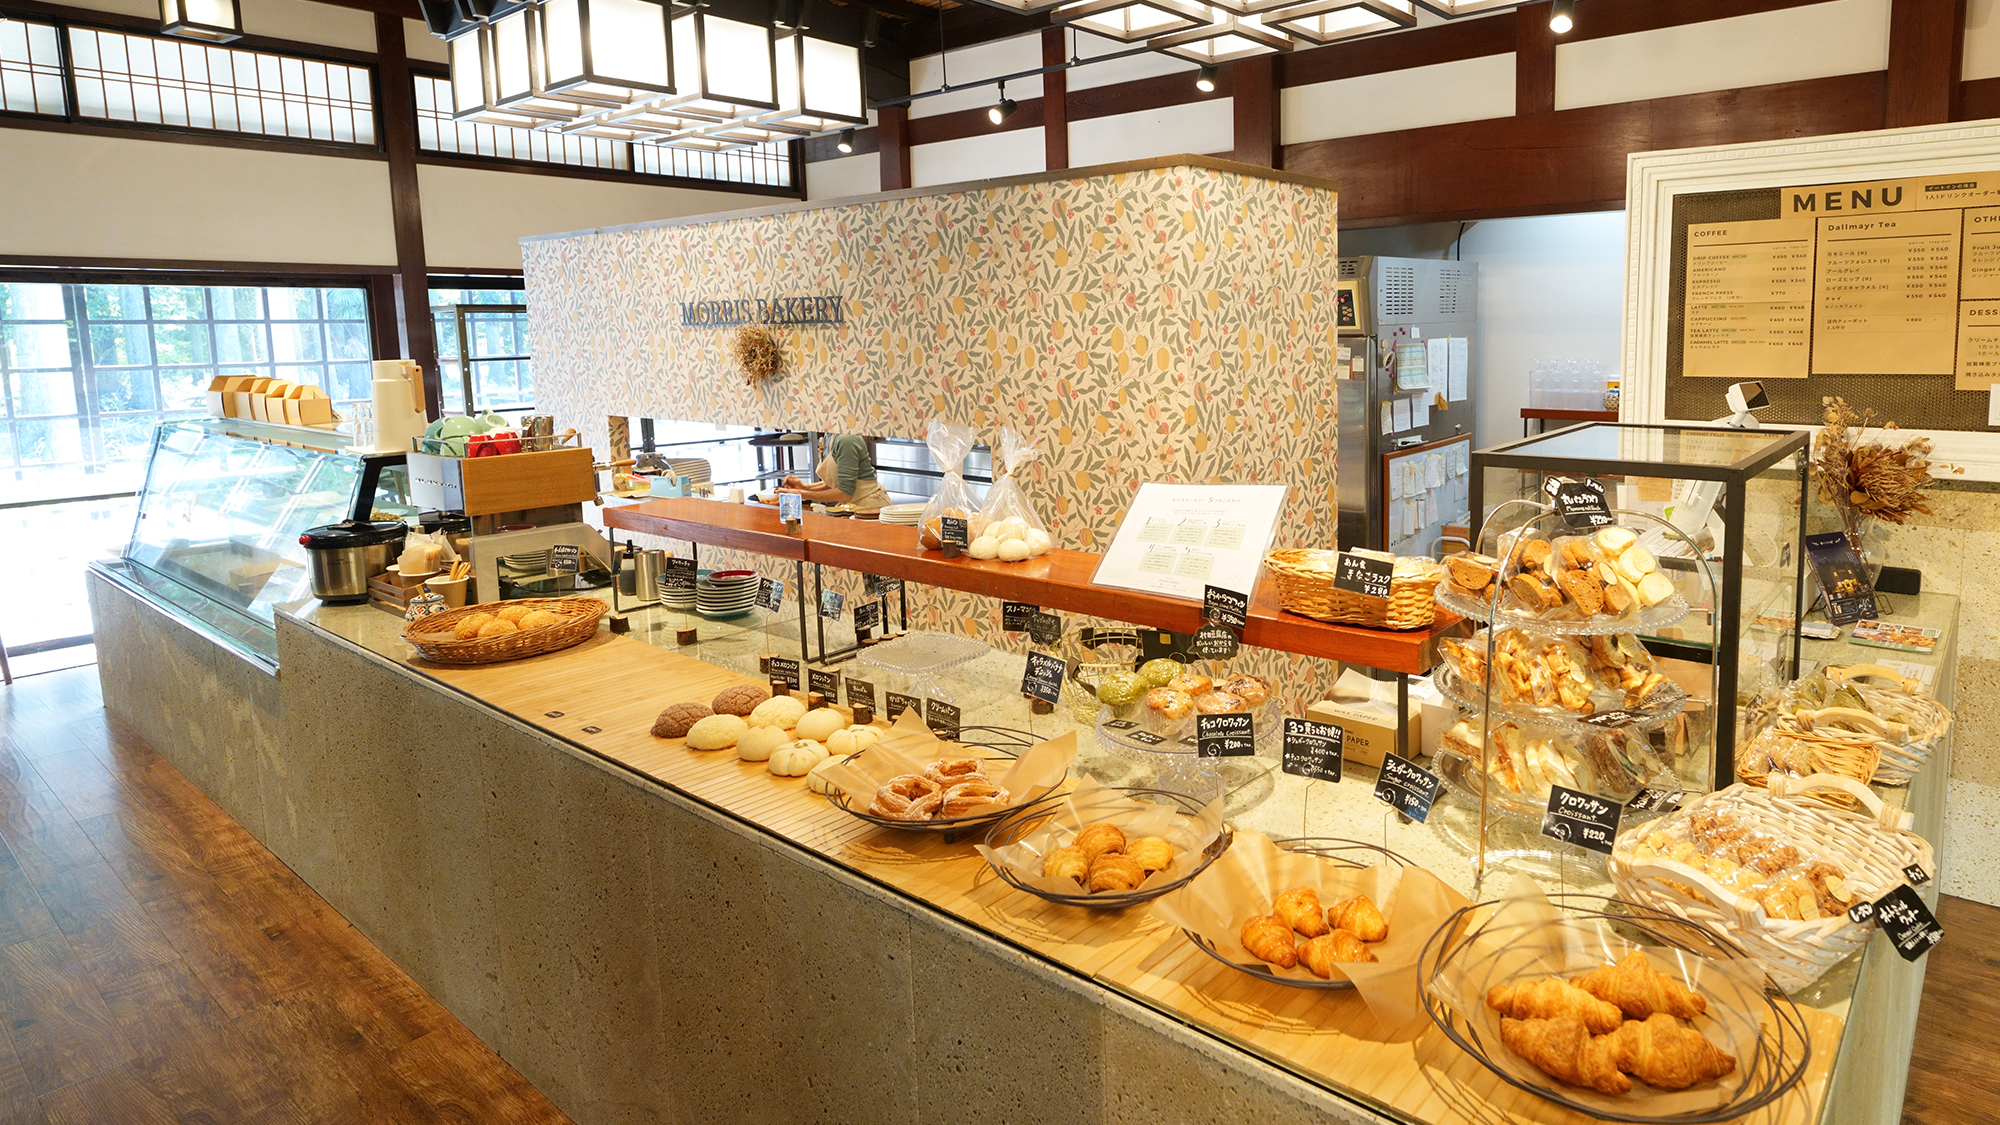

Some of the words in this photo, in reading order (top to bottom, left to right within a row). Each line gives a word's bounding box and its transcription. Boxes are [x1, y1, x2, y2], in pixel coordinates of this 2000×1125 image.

[1793, 186, 1903, 213] MENU
[1828, 222, 1874, 231] Dallmayr
[680, 299, 751, 326] MORRIS
[755, 296, 846, 325] BAKERY
[1344, 558, 1366, 569] あん食
[1346, 569, 1391, 584] きなこラスク
[1364, 585, 1388, 595] ¥280
[1200, 717, 1250, 730] チョコクロワッサン
[1353, 713, 1378, 721] PAPER
[1347, 736, 1369, 747] PAPER
[1386, 759, 1434, 789] シュガークロワッサン
[1560, 792, 1609, 815] クロワッサン
[1582, 827, 1605, 840] ¥220
[1907, 868, 1924, 881] チョコ
[1850, 904, 1873, 922] レーズン
[1880, 900, 1908, 923] オートミール
[1899, 910, 1919, 925] クッキー
